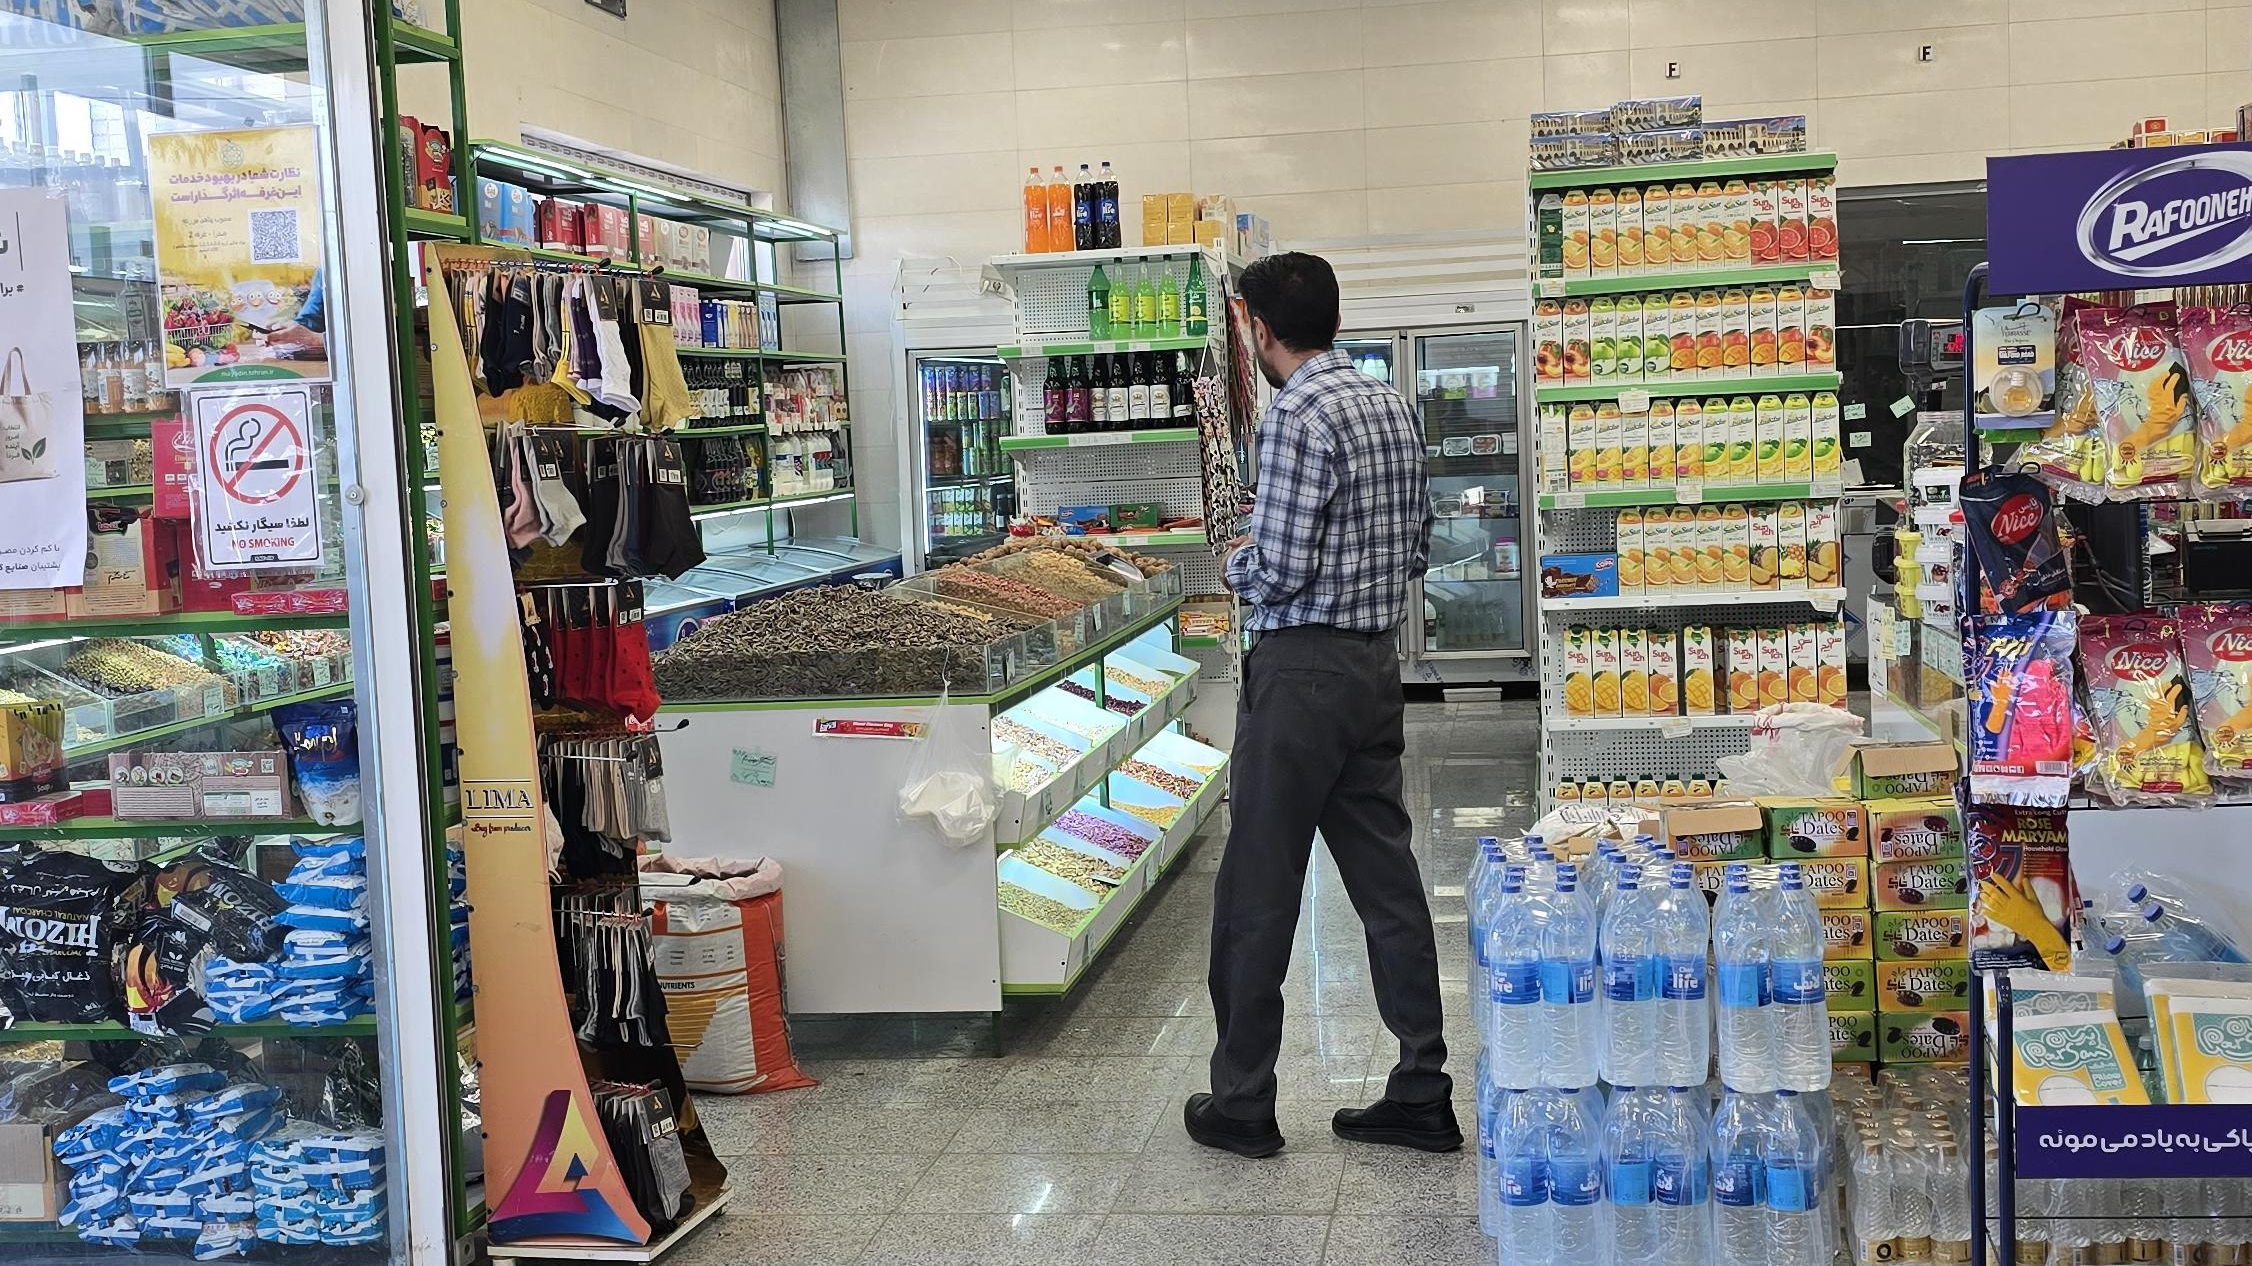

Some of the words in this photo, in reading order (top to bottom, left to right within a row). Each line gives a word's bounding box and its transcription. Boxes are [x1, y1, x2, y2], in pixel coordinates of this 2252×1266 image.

[1923, 46, 1931, 61] F
[1668, 63, 1678, 77] F
[169, 172, 203, 184] خدمات
[205, 173, 235, 185] بهبود
[236, 172, 247, 184] در
[247, 168, 269, 181] شما
[272, 168, 300, 181] نظارت
[245, 187, 278, 201] غرفه
[279, 185, 302, 199] این
[1753, 198, 1768, 208] Sun
[1782, 196, 1798, 206] Sun
[1811, 195, 1827, 205] Sun
[2109, 186, 2252, 251] RAFOONEH
[2115, 339, 2163, 361] Nice
[251, 516, 283, 533] سیگار
[285, 517, 309, 529] لطفا
[1753, 523, 1768, 531] Sun
[1997, 511, 2039, 537] Nice
[20, 544, 39, 555] کردن
[232, 540, 247, 550] NO
[249, 537, 295, 549] SMOKING
[30, 561, 61, 572] پشتیبان
[1568, 651, 1583, 659] Sun
[1596, 650, 1611, 658] Sun
[1624, 649, 1639, 657] Sun
[1652, 650, 1668, 658] Sun
[1688, 647, 1704, 656] Sun
[1733, 647, 1749, 655] Sun
[1762, 646, 1777, 655] Sun
[2115, 651, 2165, 671] Nice
[465, 789, 535, 810] LIMA
[1800, 810, 1846, 823] TAPOO
[1802, 821, 1846, 836] Dates
[2017, 817, 2053, 830] ROSE
[1895, 832, 1937, 847] Dates
[2002, 830, 2068, 844] MARYAM
[1894, 845, 1940, 858] TAPOO
[1704, 866, 1727, 877] TAP
[1909, 864, 1955, 875] TAPOO
[1911, 874, 1955, 889] Dates
[1824, 915, 1851, 927] POO
[1903, 917, 1950, 929] TAPOO
[1823, 924, 1851, 939] ates
[1906, 927, 1949, 941] Dates
[1823, 966, 1850, 977] POO
[1906, 967, 1953, 979] TAPOO
[1672, 973, 1698, 989] life
[1910, 977, 1953, 991] Dates
[1829, 1016, 1857, 1028] POO
[1830, 1030, 1857, 1041] ates
[1903, 1034, 1945, 1049] Dates
[1902, 1046, 1947, 1058] TAPOO
[2039, 1129, 2098, 1153] مونه
[2101, 1133, 2138, 1153] می
[2141, 1128, 2173, 1152] یاد
[2175, 1133, 2200, 1152] به
